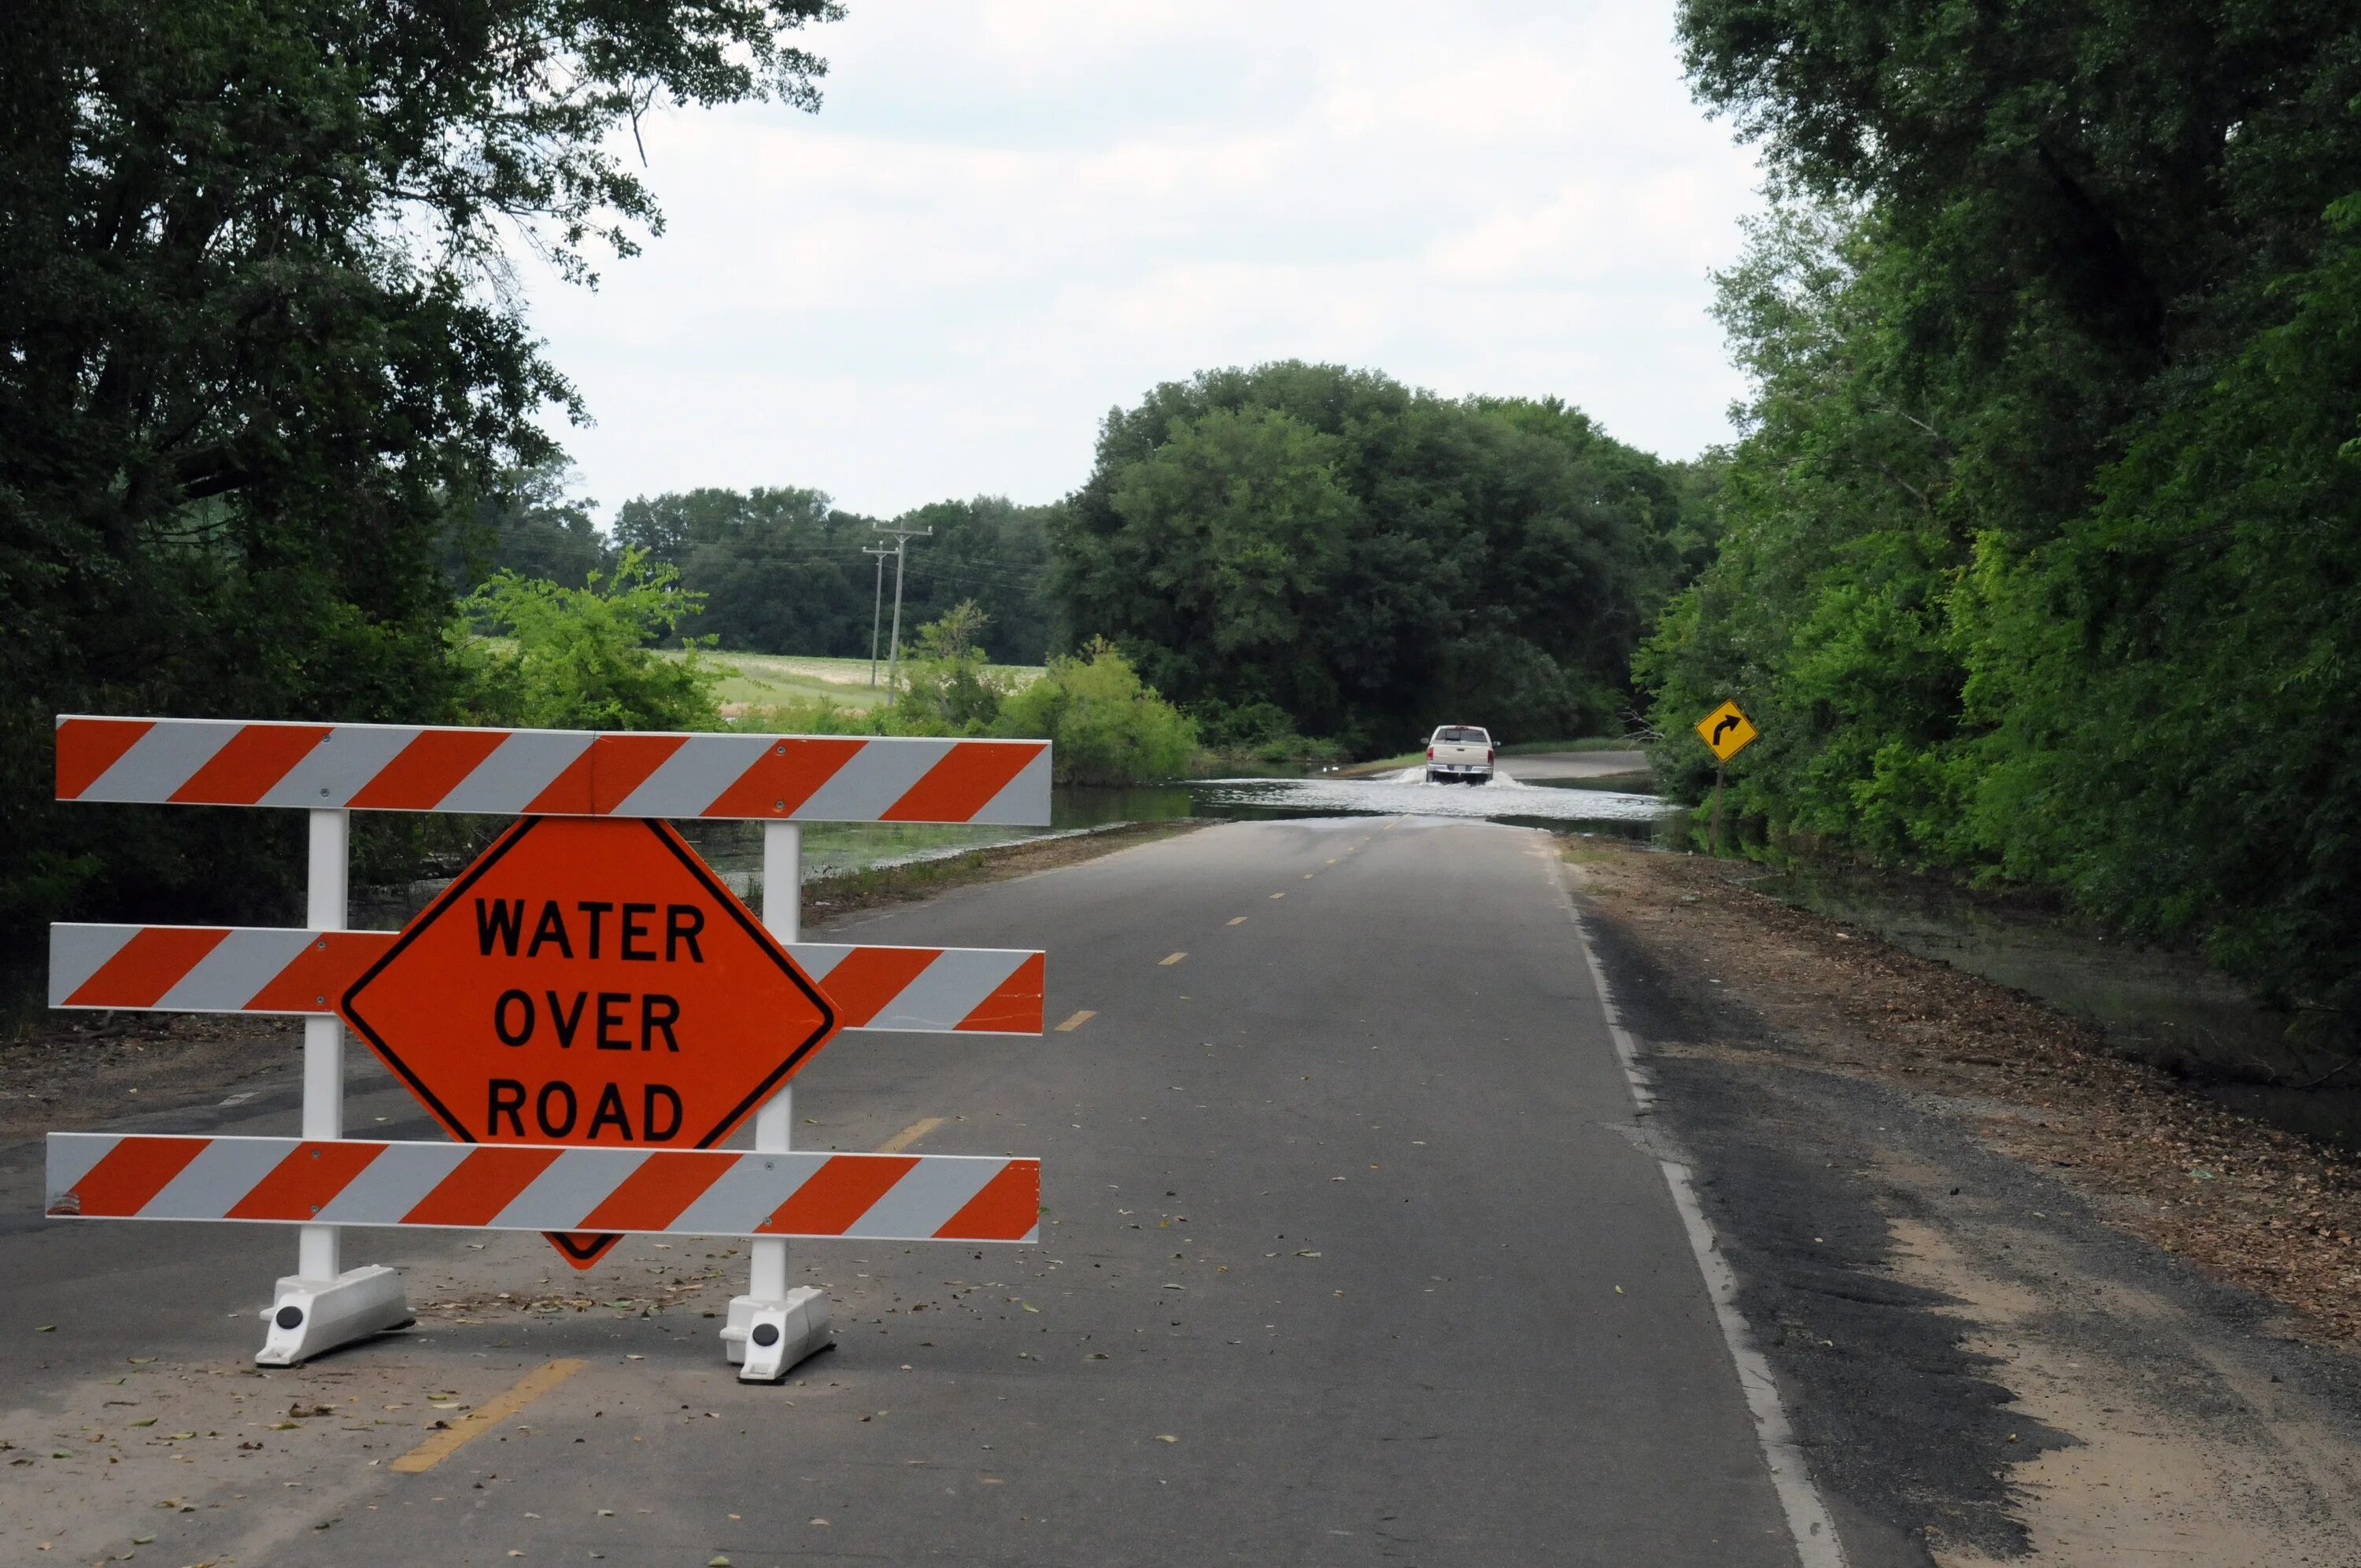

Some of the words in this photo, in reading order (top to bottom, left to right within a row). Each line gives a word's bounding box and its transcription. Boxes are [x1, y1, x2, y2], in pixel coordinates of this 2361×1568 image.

[475, 898, 704, 963] WATER
[494, 989, 680, 1052] OVER
[487, 1079, 683, 1142] ROAD
